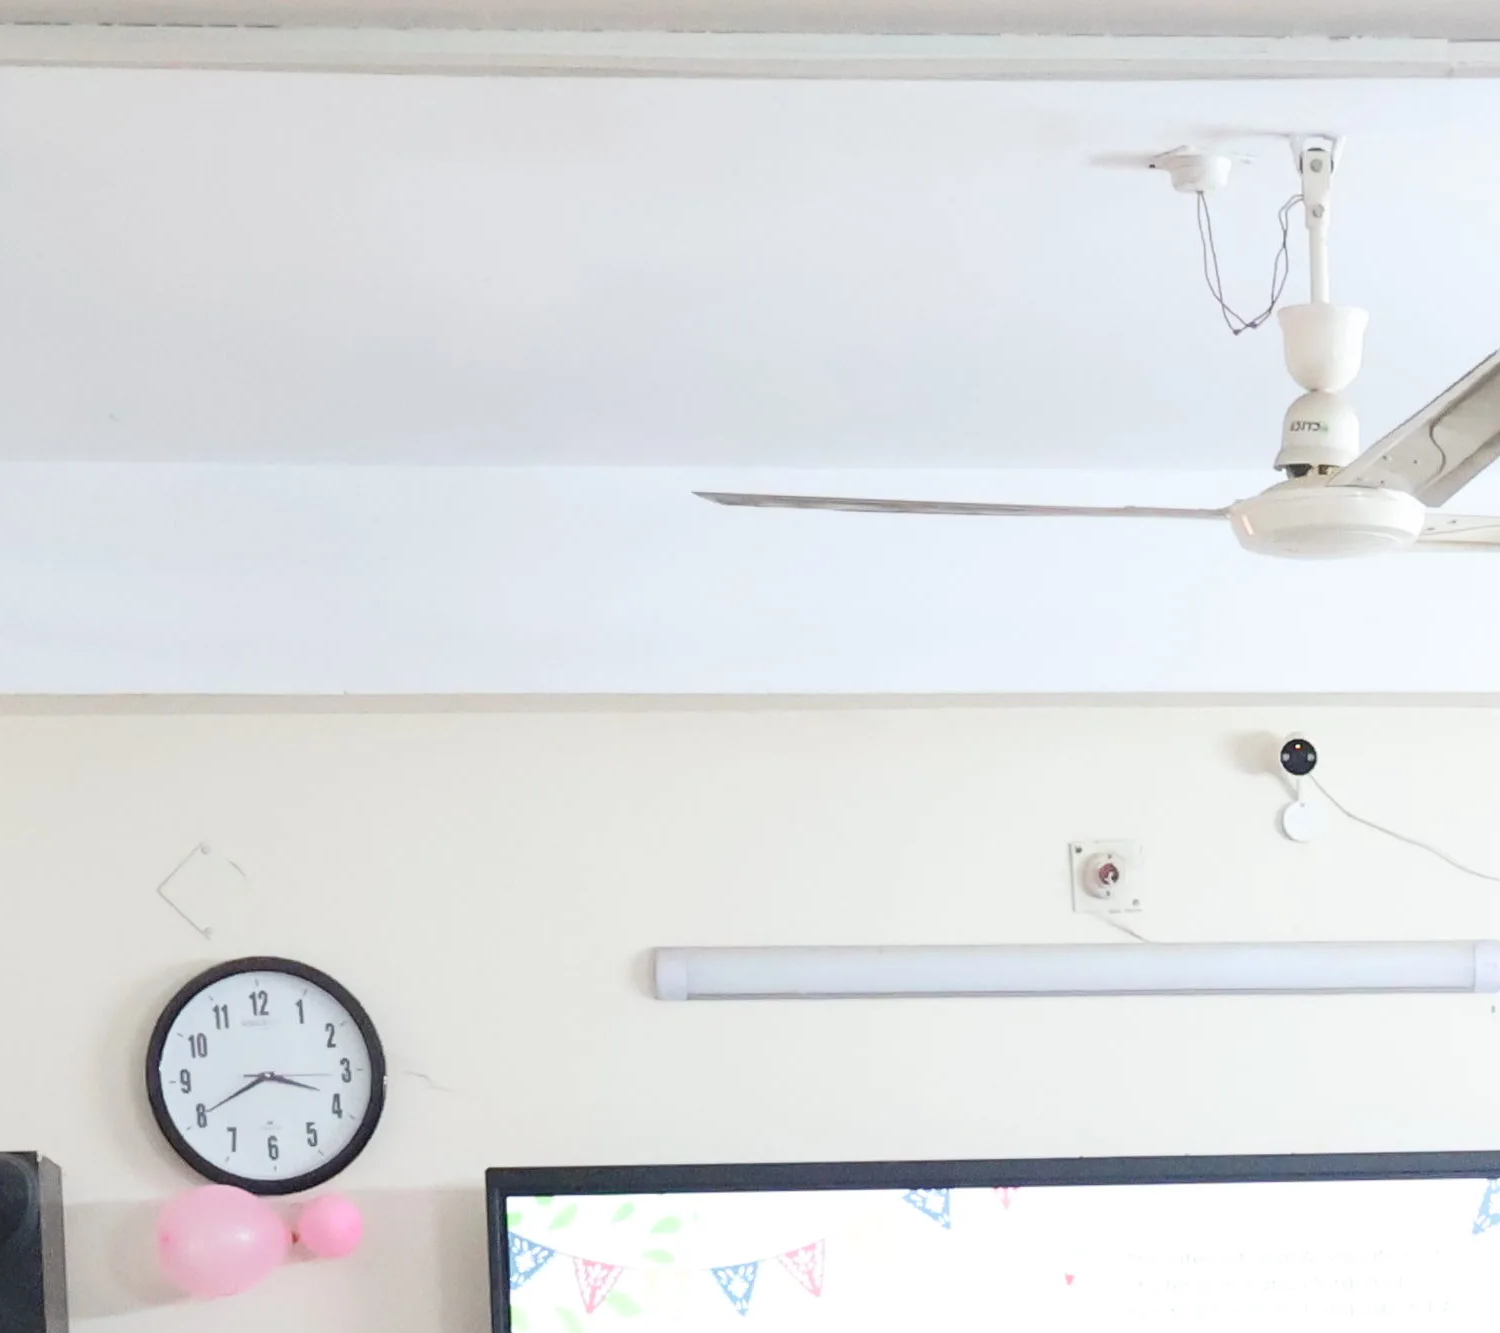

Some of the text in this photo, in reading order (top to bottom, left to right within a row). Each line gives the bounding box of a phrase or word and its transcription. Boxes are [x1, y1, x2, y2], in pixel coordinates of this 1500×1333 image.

[249, 990, 269, 1016] 12
[296, 999, 306, 1024] 1
[213, 1004, 230, 1029] 11
[188, 1033, 208, 1059] 10
[325, 1023, 336, 1048] 2
[180, 1069, 192, 1094] 9
[340, 1058, 352, 1083] 3
[196, 1103, 207, 1128] 8
[331, 1094, 343, 1119] 4
[227, 1127, 238, 1152] 7
[267, 1135, 279, 1160] 6
[306, 1122, 318, 1148] 5
